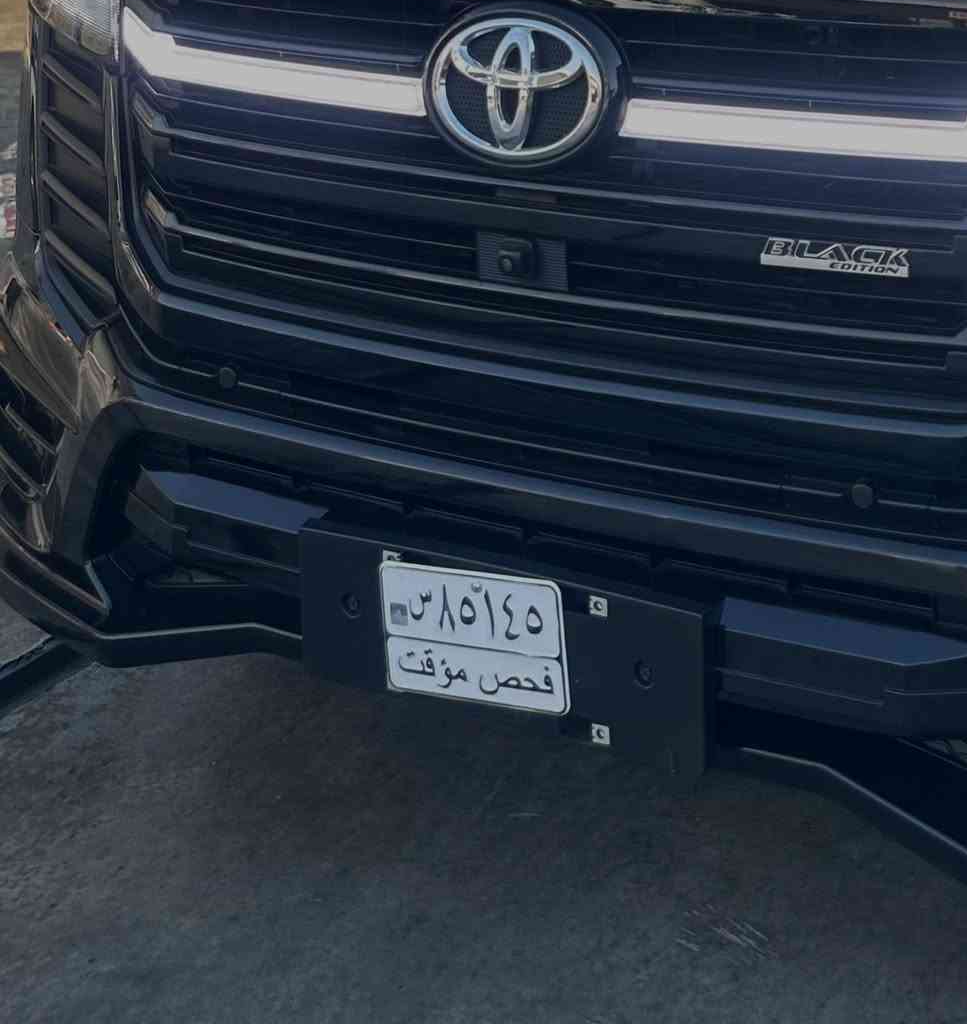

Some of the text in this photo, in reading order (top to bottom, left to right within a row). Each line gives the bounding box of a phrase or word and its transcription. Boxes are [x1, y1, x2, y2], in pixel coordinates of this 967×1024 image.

[762, 236, 910, 267] BLACK
[828, 261, 900, 275] EDITION
[397, 648, 555, 695] فحص مؤقت
